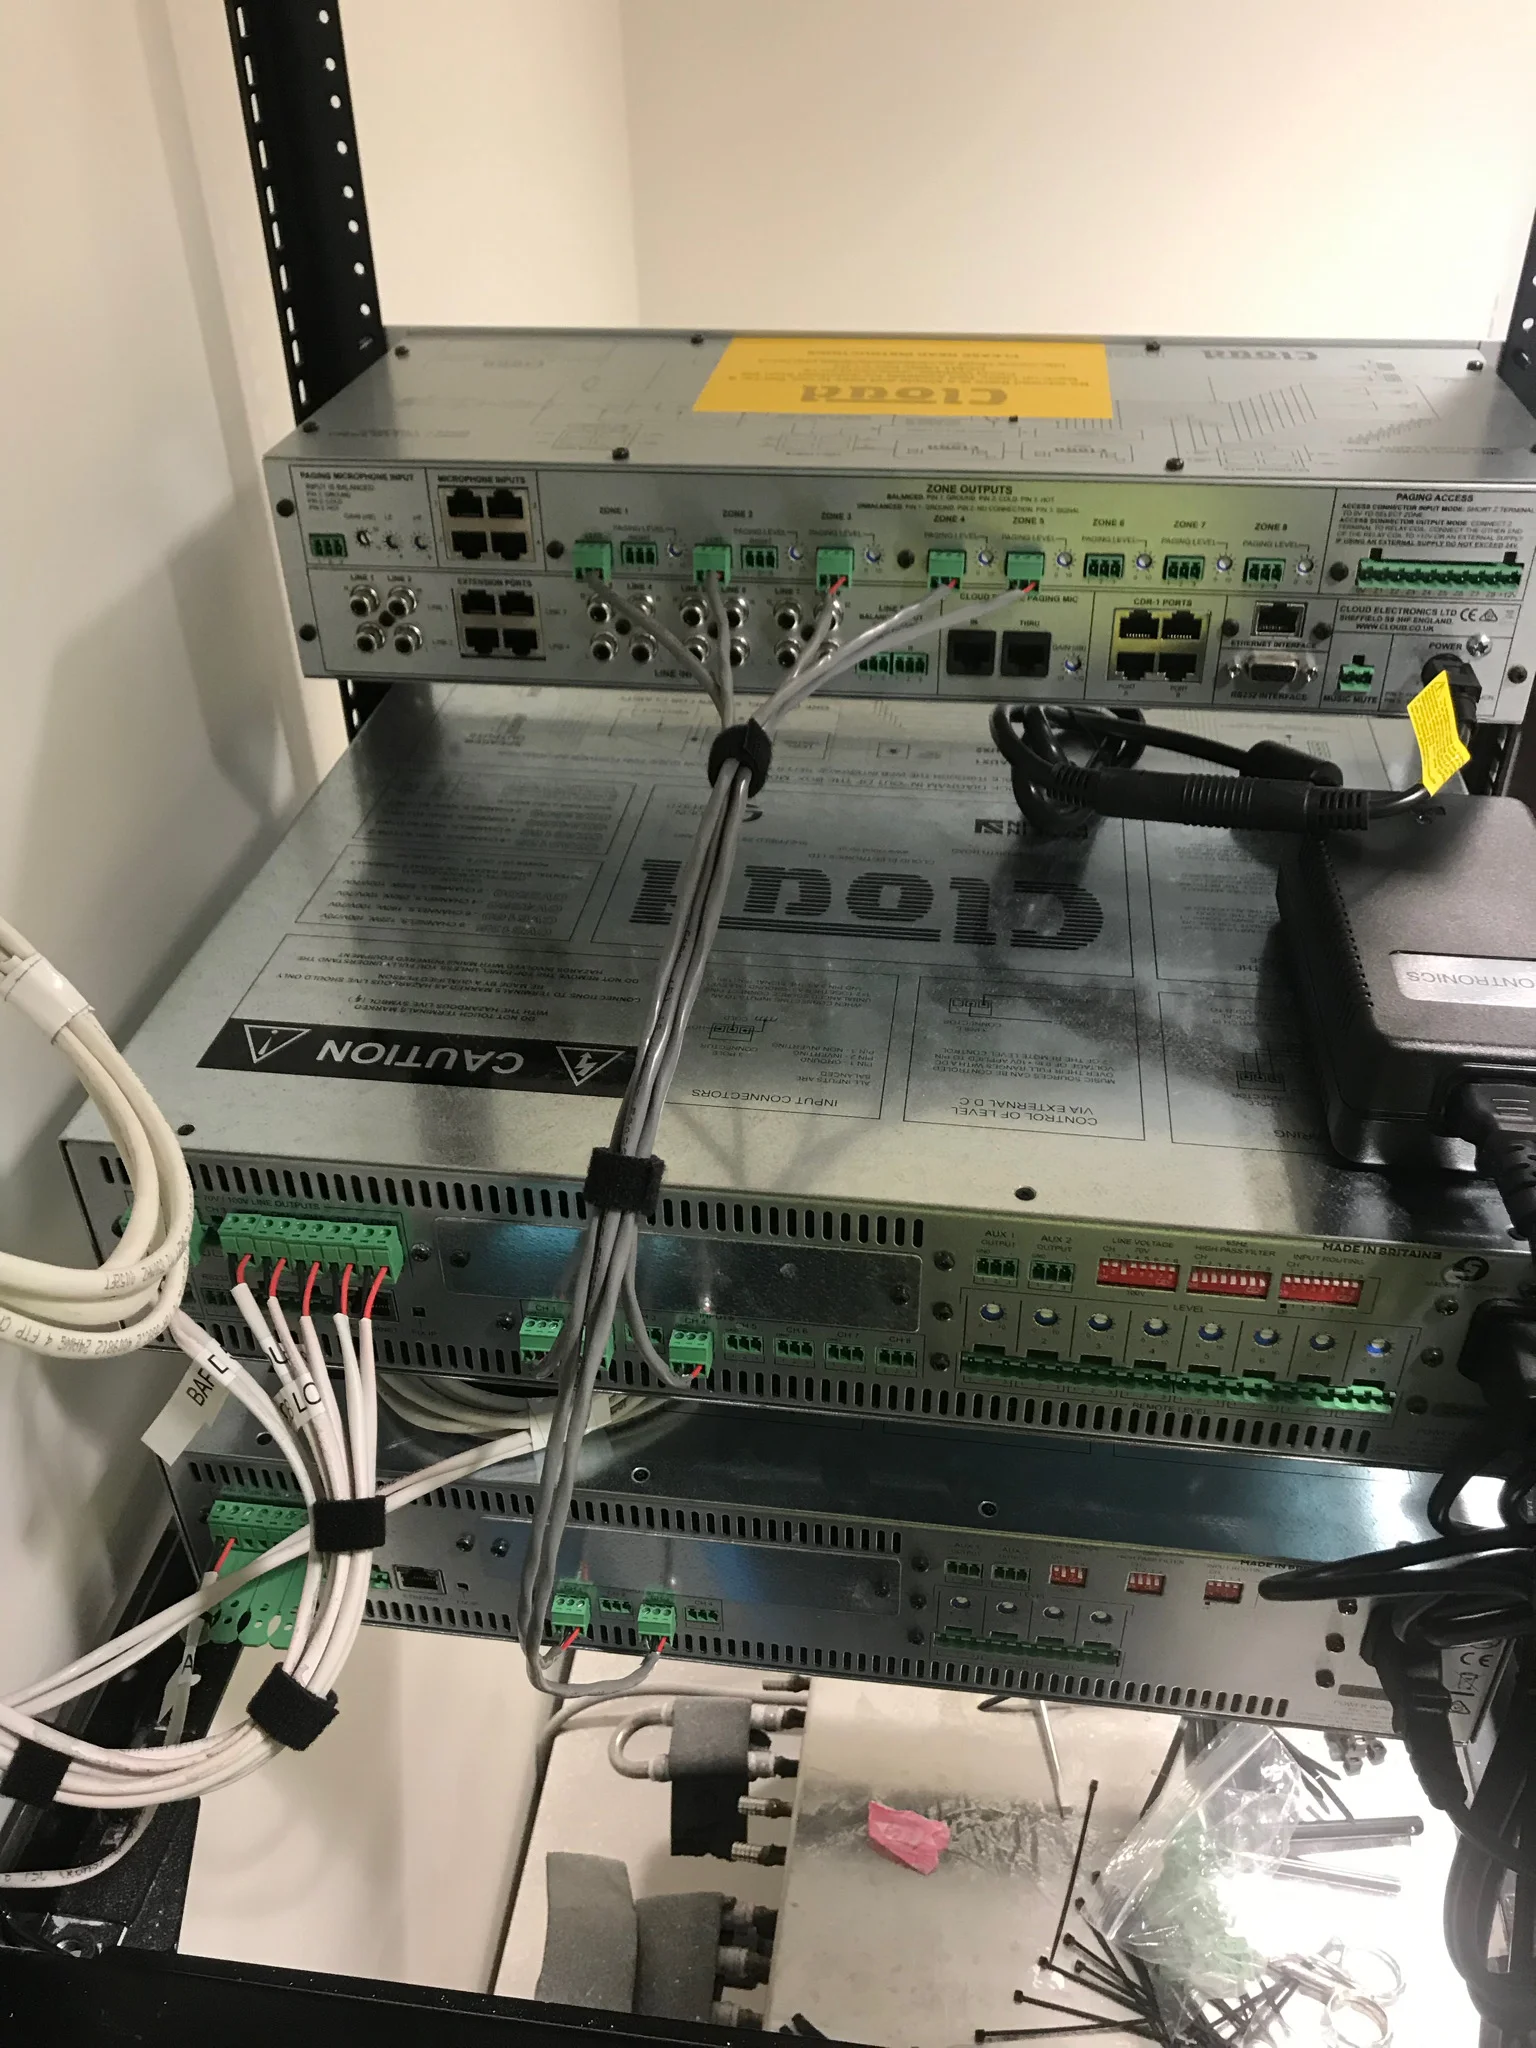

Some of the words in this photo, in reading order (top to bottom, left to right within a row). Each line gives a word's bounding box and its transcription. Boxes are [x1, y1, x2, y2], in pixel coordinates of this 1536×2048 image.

[926, 484, 956, 494] ZONE
[959, 485, 1013, 495] OUTPUTS
[1396, 493, 1433, 502] PAGING
[1435, 494, 1474, 503] ACCESS
[821, 512, 846, 521] ZONE
[933, 515, 958, 524] ZONE
[1012, 516, 1037, 525] ZONE
[1092, 518, 1117, 527] ZONE
[1173, 520, 1198, 529] ZONE
[1254, 522, 1280, 531] ZONE
[1340, 606, 1372, 614] CLOUD
[1373, 606, 1438, 616] ELECTRONICS
[1428, 642, 1463, 650] POWER
[1352, 695, 1378, 703] MUTE
[1406, 971, 1536, 989] ONTRONICS
[315, 1038, 525, 1075] CAUTION
[816, 1076, 851, 1085] INPUTS
[1010, 1071, 1031, 1080] CAN
[1033, 1072, 1081, 1083] SOURCES
[1084, 1076, 1116, 1085] MUSIC
[690, 1088, 792, 1105] CONNECTORS
[794, 1096, 838, 1107] INPUT
[988, 1099, 1066, 1113] EXTERNAL
[1069, 1106, 1093, 1116] VIA
[950, 1106, 996, 1118] LEVEL
[1000, 1110, 1021, 1120] OF
[1024, 1111, 1098, 1127] CONTROL
[274, 1199, 320, 1210] OUTPUTS
[985, 1229, 1009, 1238] AUX
[1040, 1234, 1065, 1243] AUX
[980, 1239, 1016, 1249] OUTPUT
[1036, 1243, 1073, 1253] OUTPUT
[1112, 1237, 1132, 1246] LINE
[1134, 1239, 1174, 1249] VOLTAGE
[1322, 1242, 1360, 1254] MADE
[1362, 1244, 1376, 1255] IN
[1380, 1246, 1429, 1259] BRITAIN
[1293, 1254, 1321, 1262] INPUT
[1322, 1256, 1365, 1265] ROUTING
[1173, 1304, 1204, 1313] LEVEL
[889, 1335, 903, 1343] CH
[1131, 1402, 1170, 1411] REMOTE
[1174, 1405, 1207, 1415] LEVEL
[1240, 1559, 1273, 1568] MADE
